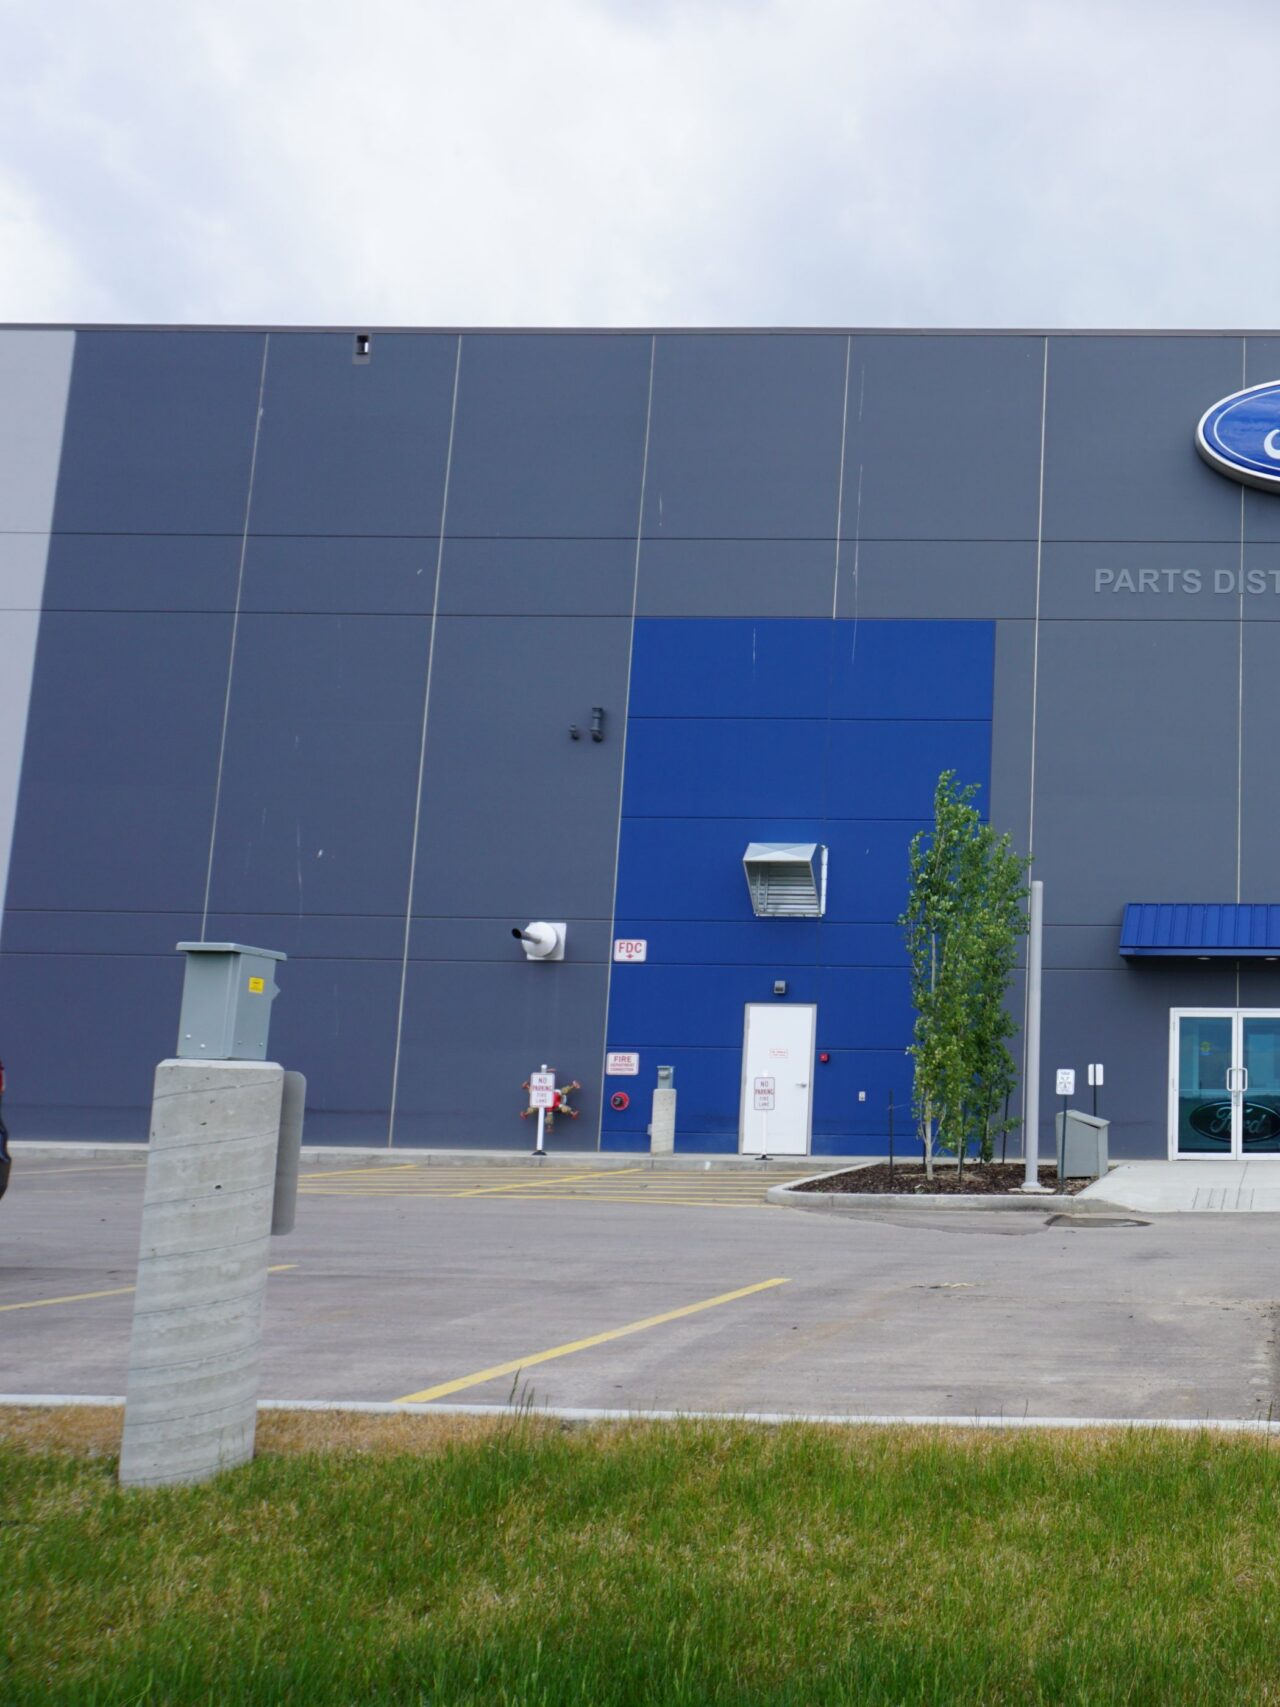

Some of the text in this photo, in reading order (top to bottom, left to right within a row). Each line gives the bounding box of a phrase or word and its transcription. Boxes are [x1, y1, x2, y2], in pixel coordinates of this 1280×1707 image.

[1095, 568, 1202, 594] PARTS
[618, 942, 642, 953] FDC
[613, 1055, 632, 1063] FIRE
[760, 1080, 769, 1088] NO
[1210, 1106, 1267, 1133] Fd
